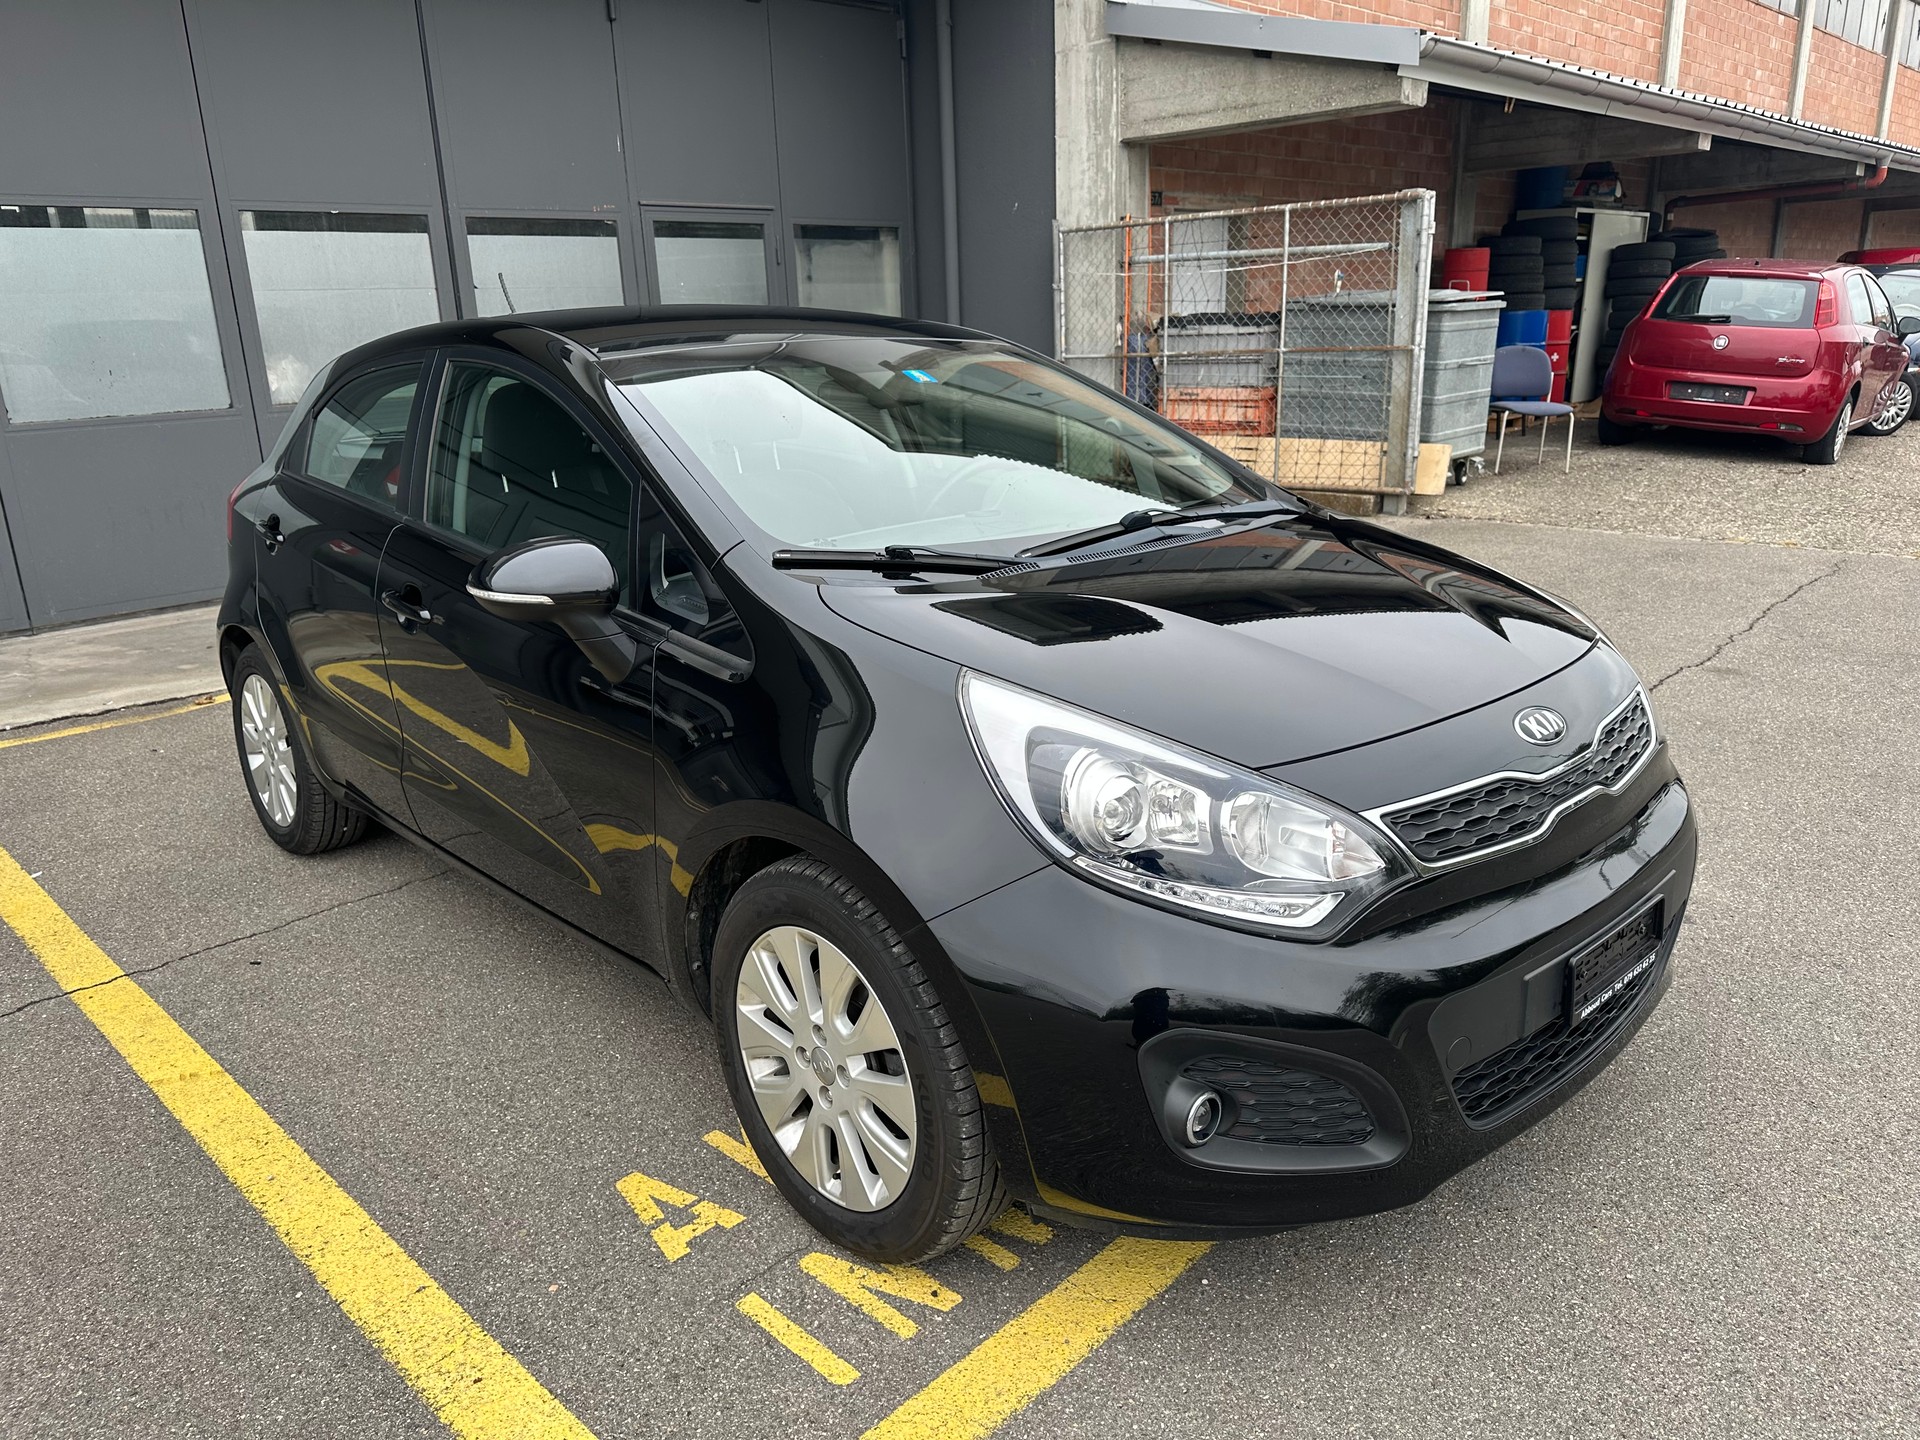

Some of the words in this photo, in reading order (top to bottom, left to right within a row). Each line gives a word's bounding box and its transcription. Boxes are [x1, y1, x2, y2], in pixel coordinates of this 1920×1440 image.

[1521, 710, 1564, 740] KIA
[1601, 990, 1613, 1002] Cars
[1614, 980, 1623, 992] Tel.
[1624, 972, 1633, 984] 079
[915, 1072, 936, 1182] KUMHO
